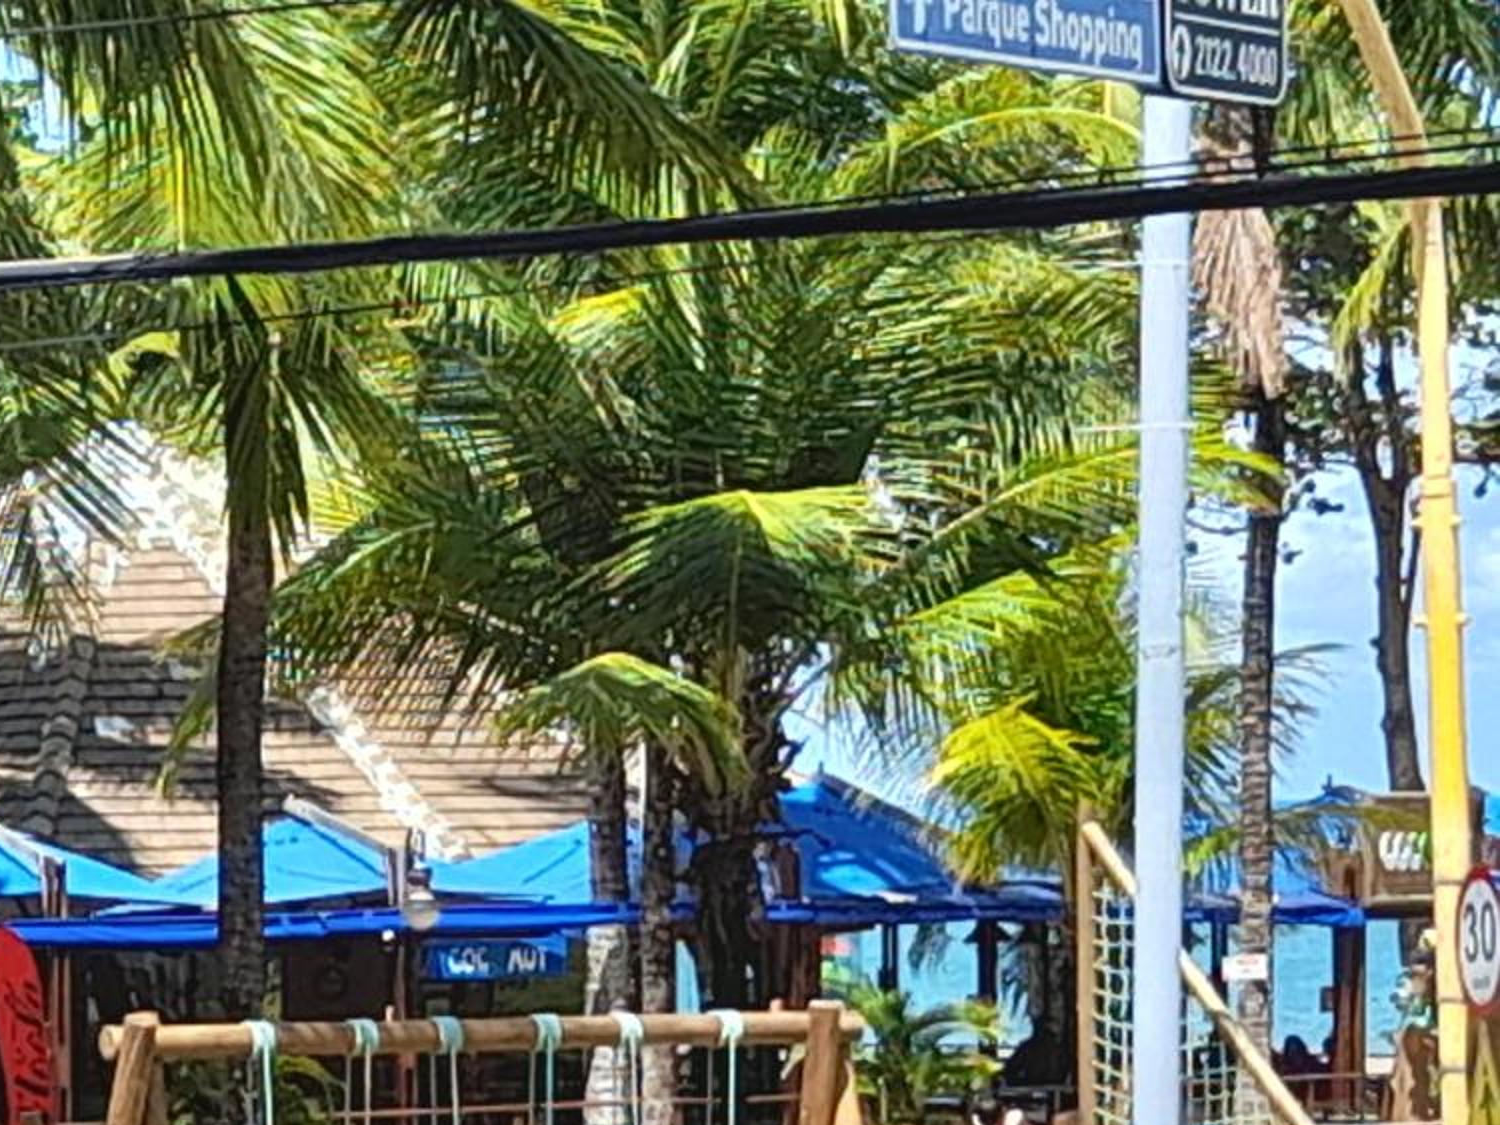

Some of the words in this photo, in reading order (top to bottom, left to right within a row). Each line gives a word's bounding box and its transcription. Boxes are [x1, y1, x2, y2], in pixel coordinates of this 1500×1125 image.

[942, 0, 1030, 49] Parque
[1034, 0, 1144, 71] Shopping
[1463, 902, 1497, 963] 30
